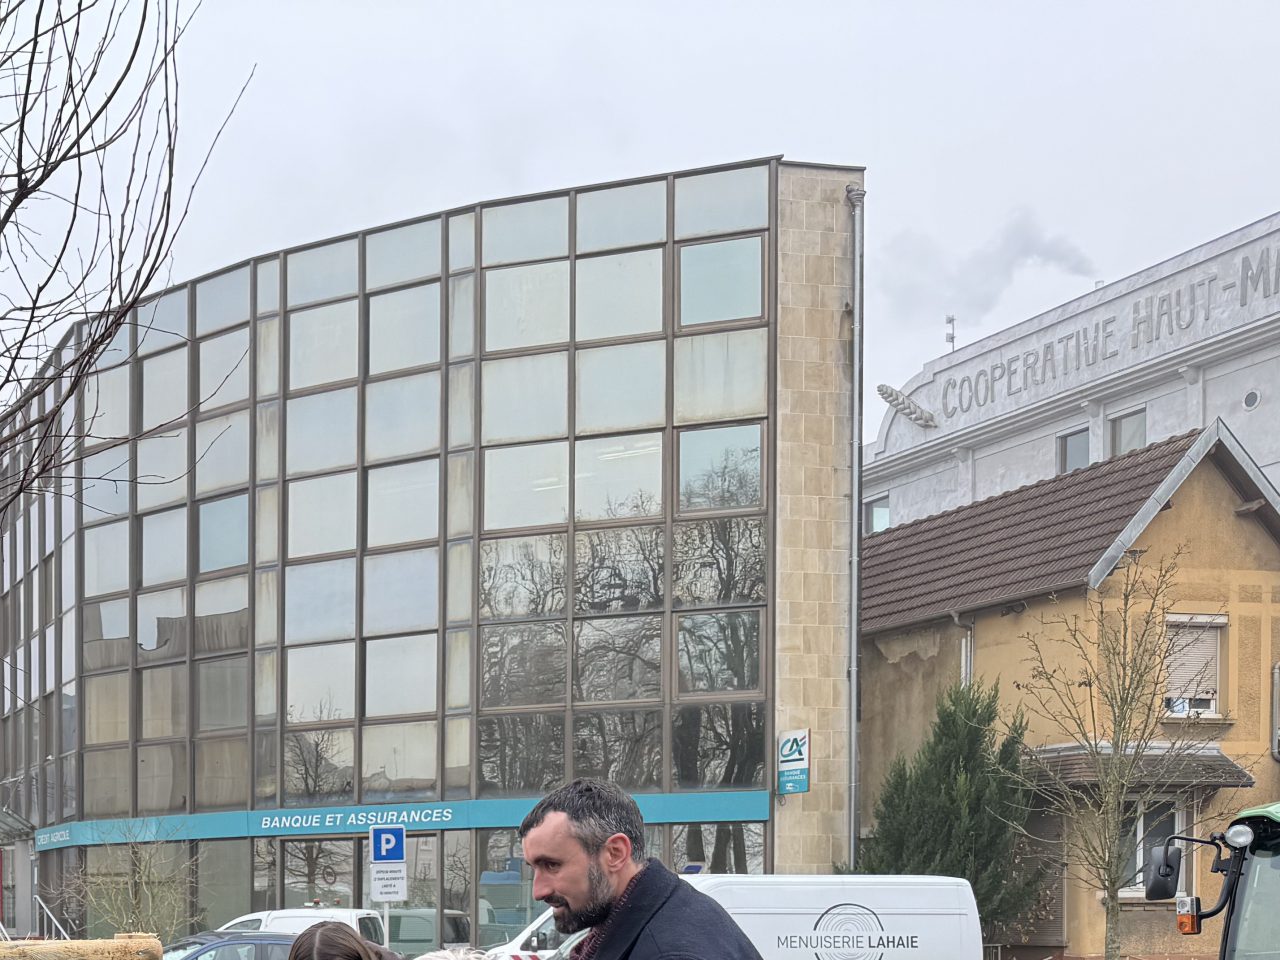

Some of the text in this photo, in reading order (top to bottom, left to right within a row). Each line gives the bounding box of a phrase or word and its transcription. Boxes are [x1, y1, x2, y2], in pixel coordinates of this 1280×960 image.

[942, 315, 1119, 419] COOPERATIVE
[261, 808, 453, 829] BANQUE ET ASSURANCES
[381, 833, 396, 856] P
[777, 936, 919, 948] MENUISERIE LAHAIE
